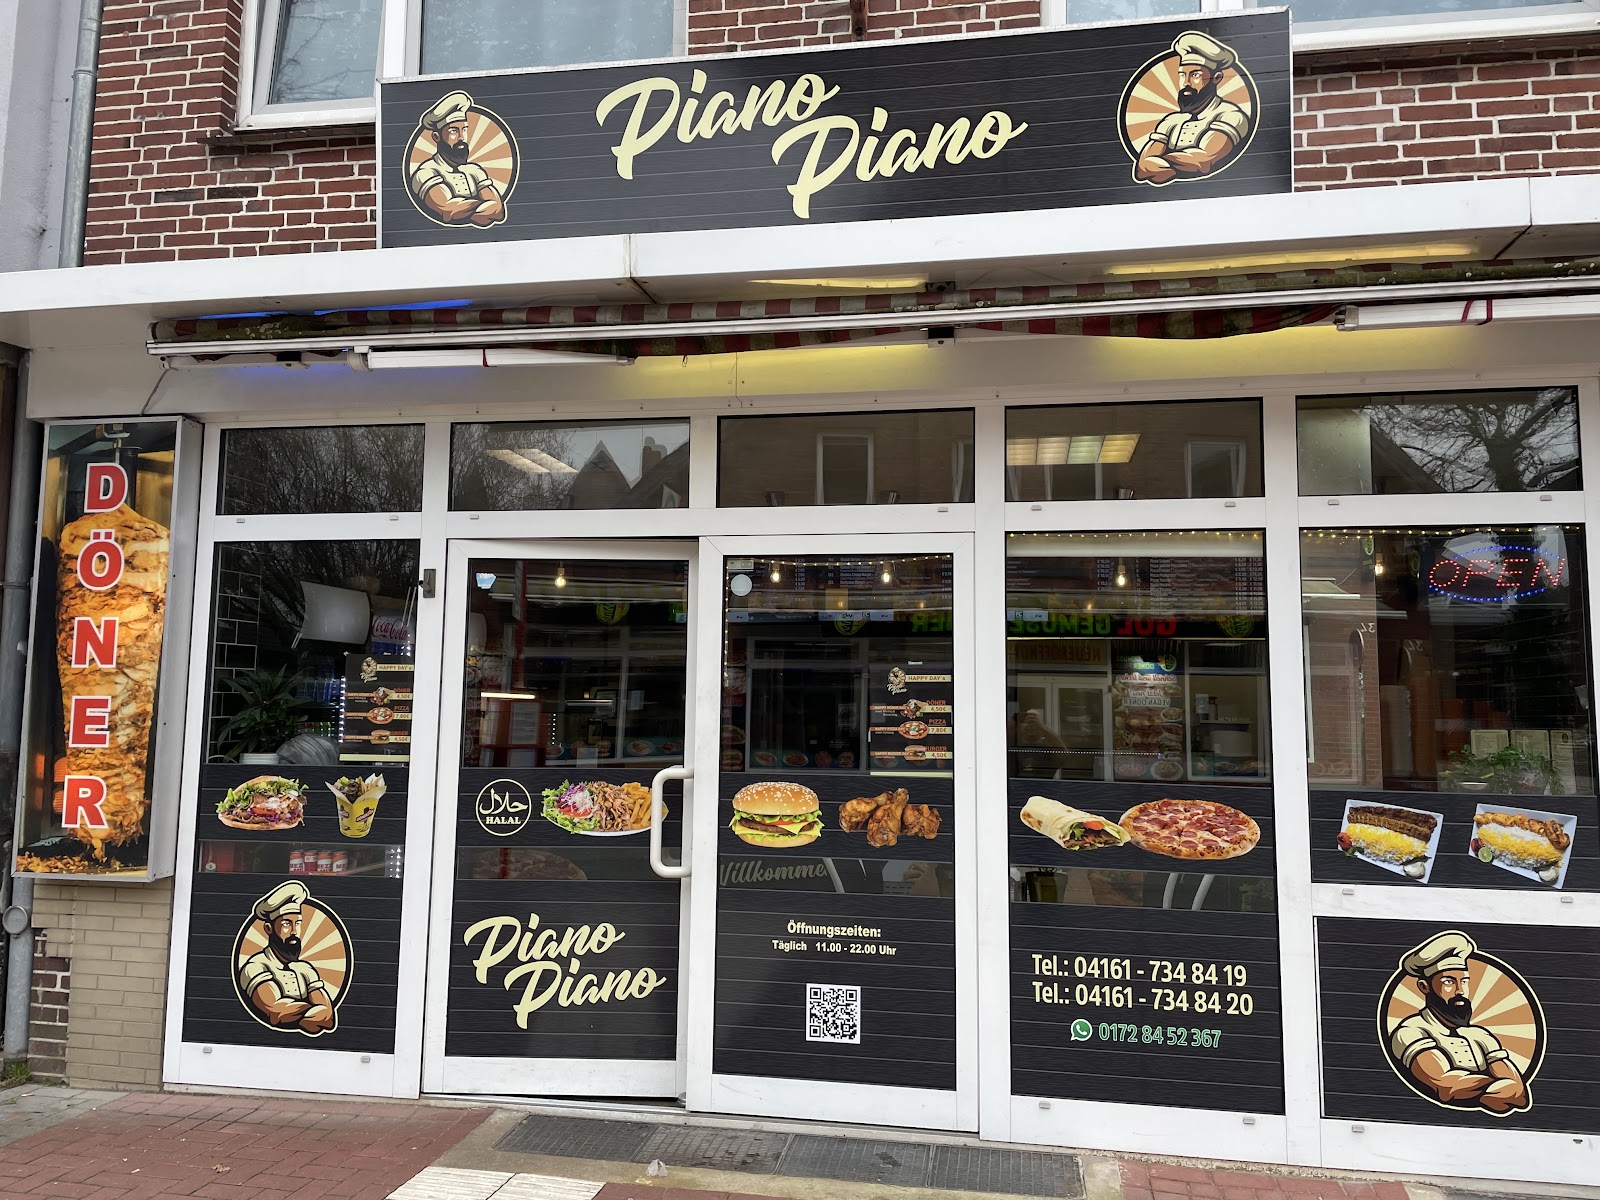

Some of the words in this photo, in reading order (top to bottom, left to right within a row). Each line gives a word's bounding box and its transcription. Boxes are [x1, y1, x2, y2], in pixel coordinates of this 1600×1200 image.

[596, 69, 840, 180] Piano
[771, 107, 1027, 220] Piano
[1428, 557, 1566, 588] OPEN
[61, 462, 129, 829] DÖNER
[479, 787, 529, 815] حلال
[485, 816, 522, 825] HALAL
[786, 919, 882, 939] Öffnungszeiten:
[463, 913, 626, 985] Piano
[772, 939, 808, 954] Täglich
[815, 942, 842, 954] 11.00
[850, 944, 877, 956] 22.00
[879, 946, 898, 957] Uhr
[1031, 953, 1069, 976] Tel.:
[1074, 956, 1131, 980] 04161
[1149, 960, 1187, 983] 734
[1191, 963, 1218, 985] 84
[1223, 965, 1247, 987] 19
[503, 958, 668, 1030] Piano
[1032, 981, 1070, 1005] Tel.:
[1075, 983, 1133, 1008] 04161
[1151, 988, 1189, 1012] 734
[1193, 990, 1222, 1014] 84
[1226, 993, 1254, 1016] 20
[1099, 1022, 1138, 1043] 0172
[1142, 1025, 1164, 1045] 84
[1166, 1027, 1188, 1046] 52
[1191, 1028, 1222, 1048] 367
